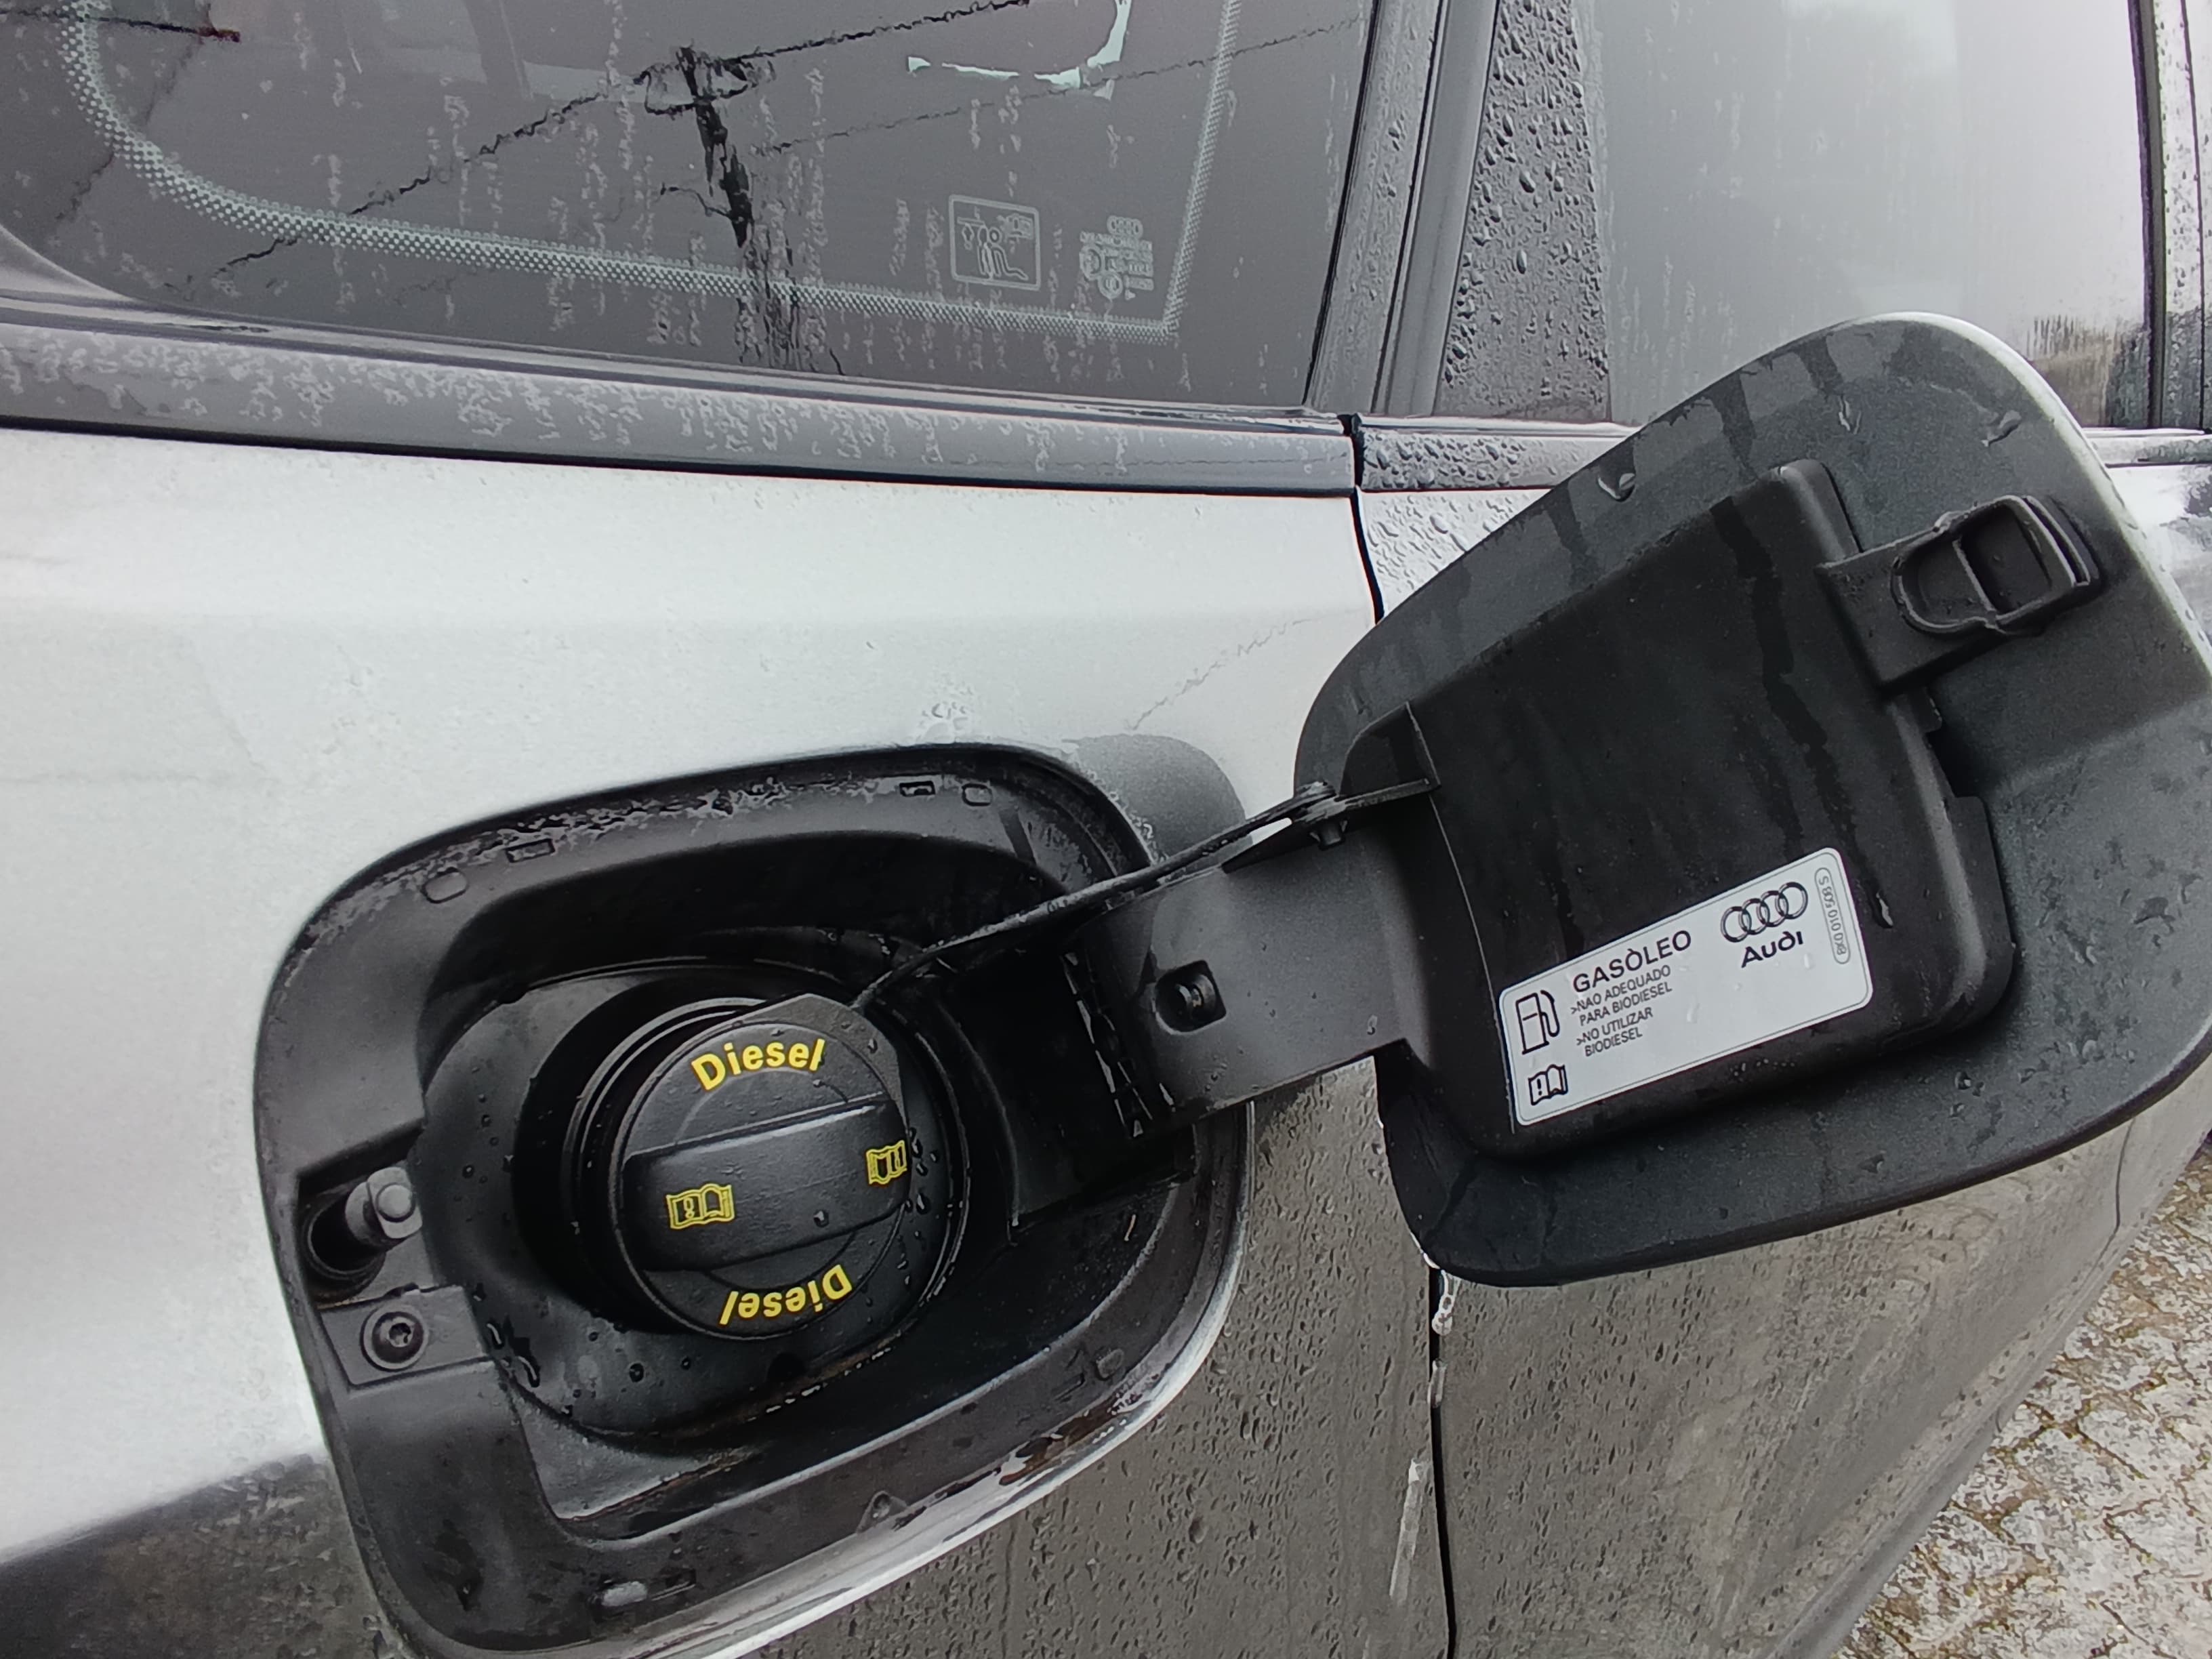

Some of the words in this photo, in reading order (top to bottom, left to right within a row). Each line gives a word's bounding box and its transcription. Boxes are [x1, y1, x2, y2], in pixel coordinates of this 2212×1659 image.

[1740, 930, 1803, 968] Audi
[1604, 964, 1672, 1001] ADEQUADO
[1579, 1005, 1611, 1026] PARA
[1612, 982, 1673, 1014] BIODIESEL
[1603, 1007, 1654, 1037] UTILIZAR
[1584, 1028, 1643, 1057] BIODIESEL
[691, 1038, 825, 1091] Diesel
[719, 1265, 853, 1325] Diesel
